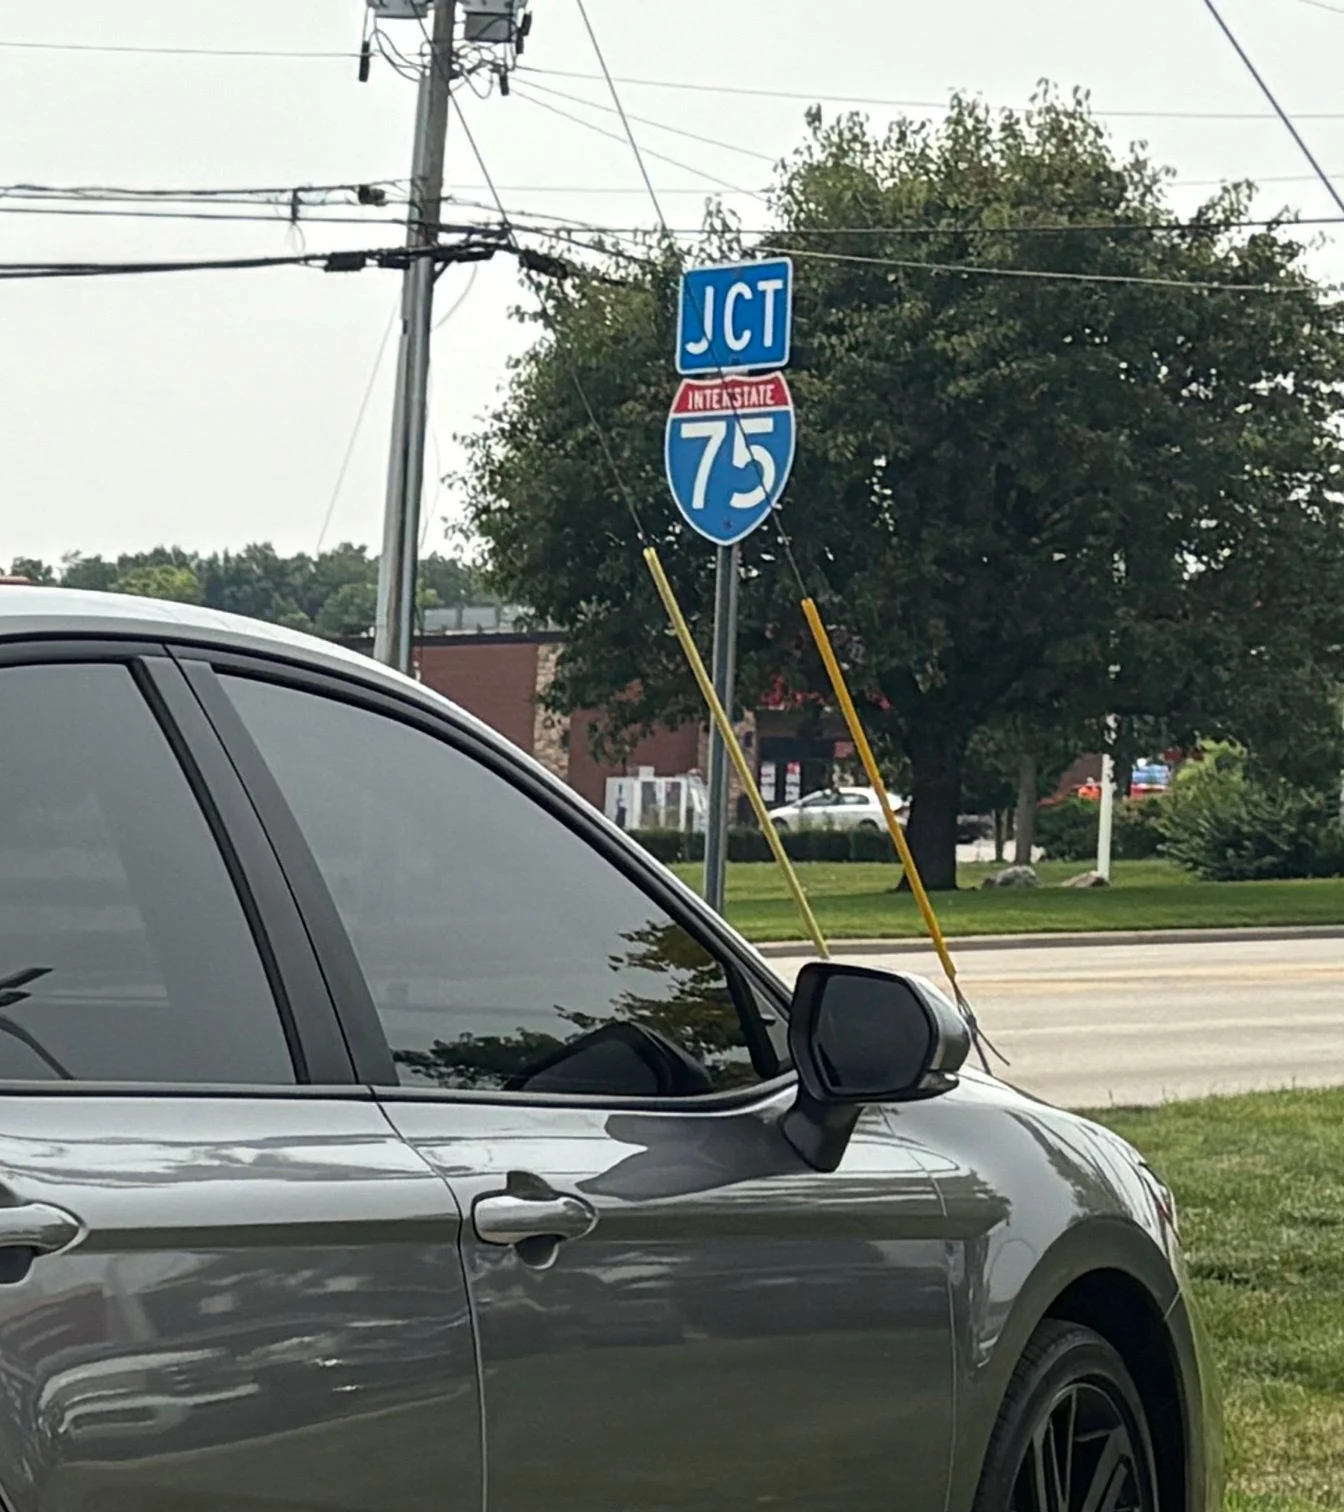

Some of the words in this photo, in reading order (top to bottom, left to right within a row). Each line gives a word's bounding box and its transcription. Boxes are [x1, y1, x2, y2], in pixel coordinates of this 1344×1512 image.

[685, 279, 783, 355] JCT
[688, 384, 775, 411] INTERSTATE
[680, 417, 776, 509] 75
